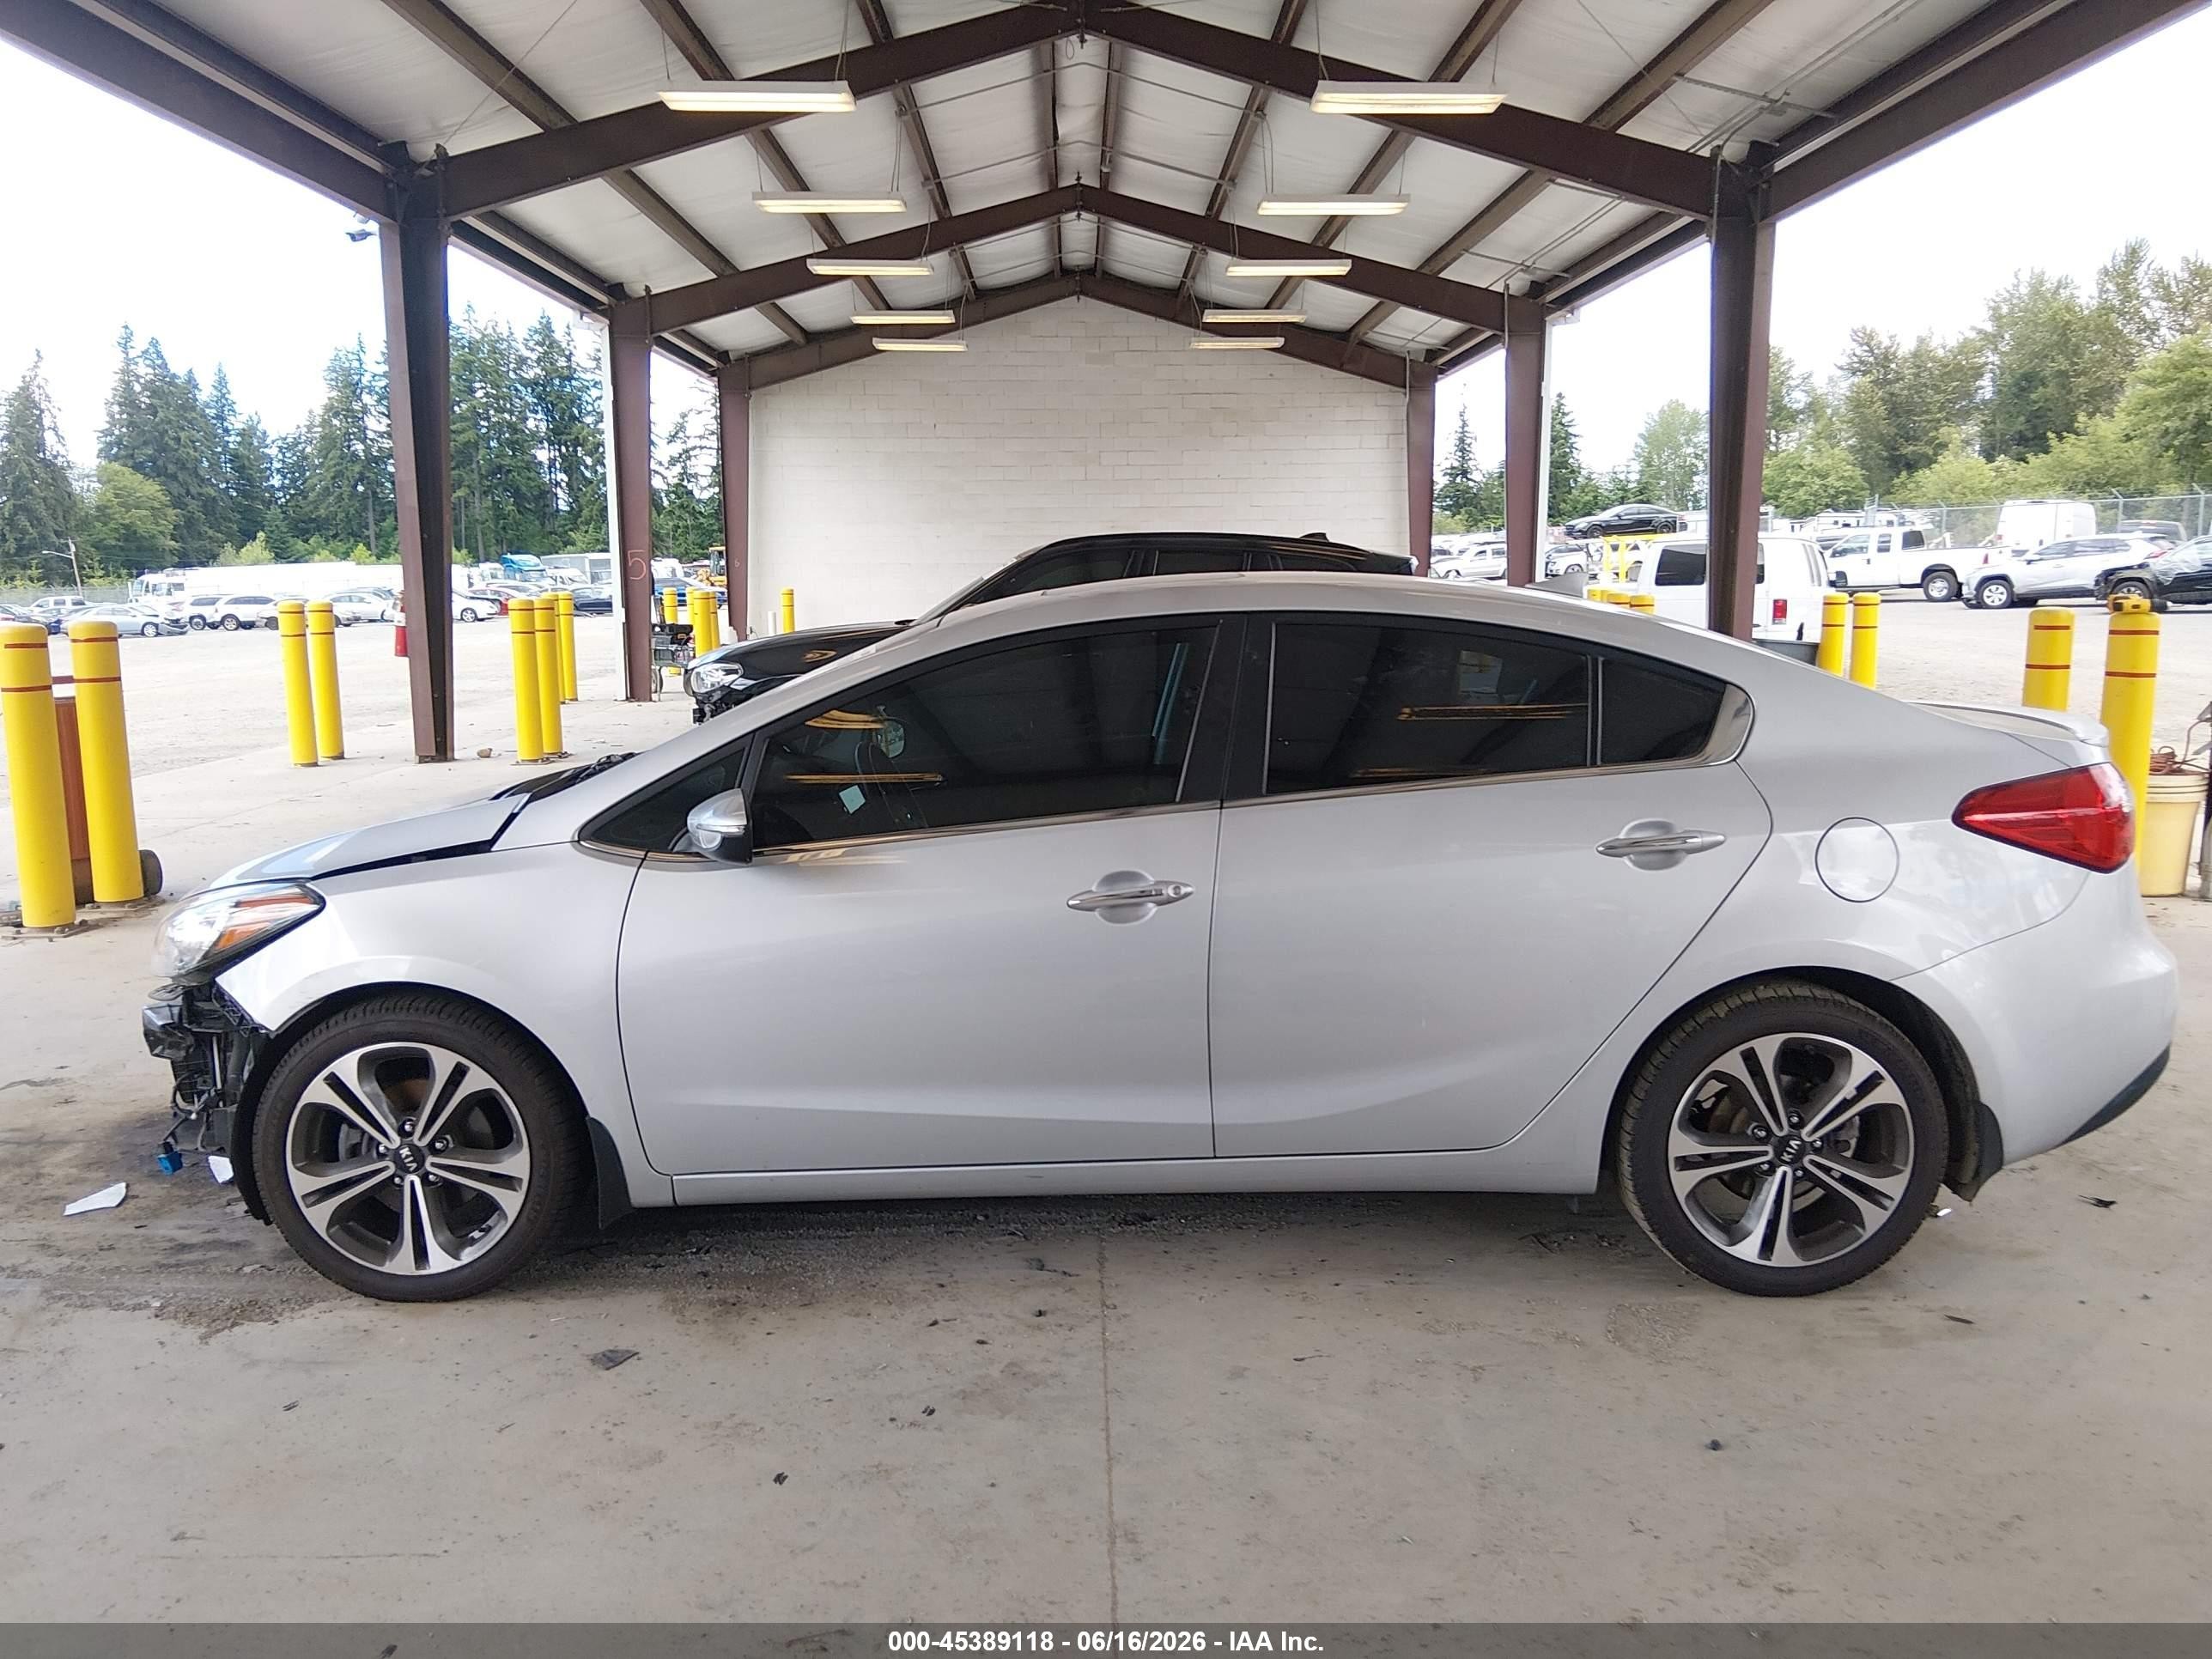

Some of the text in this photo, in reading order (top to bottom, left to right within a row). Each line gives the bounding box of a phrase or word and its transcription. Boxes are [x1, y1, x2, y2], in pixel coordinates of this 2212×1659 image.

[627, 549, 647, 580] 5
[398, 1146, 418, 1171] KIA
[1780, 1139, 1802, 1162] KIA
